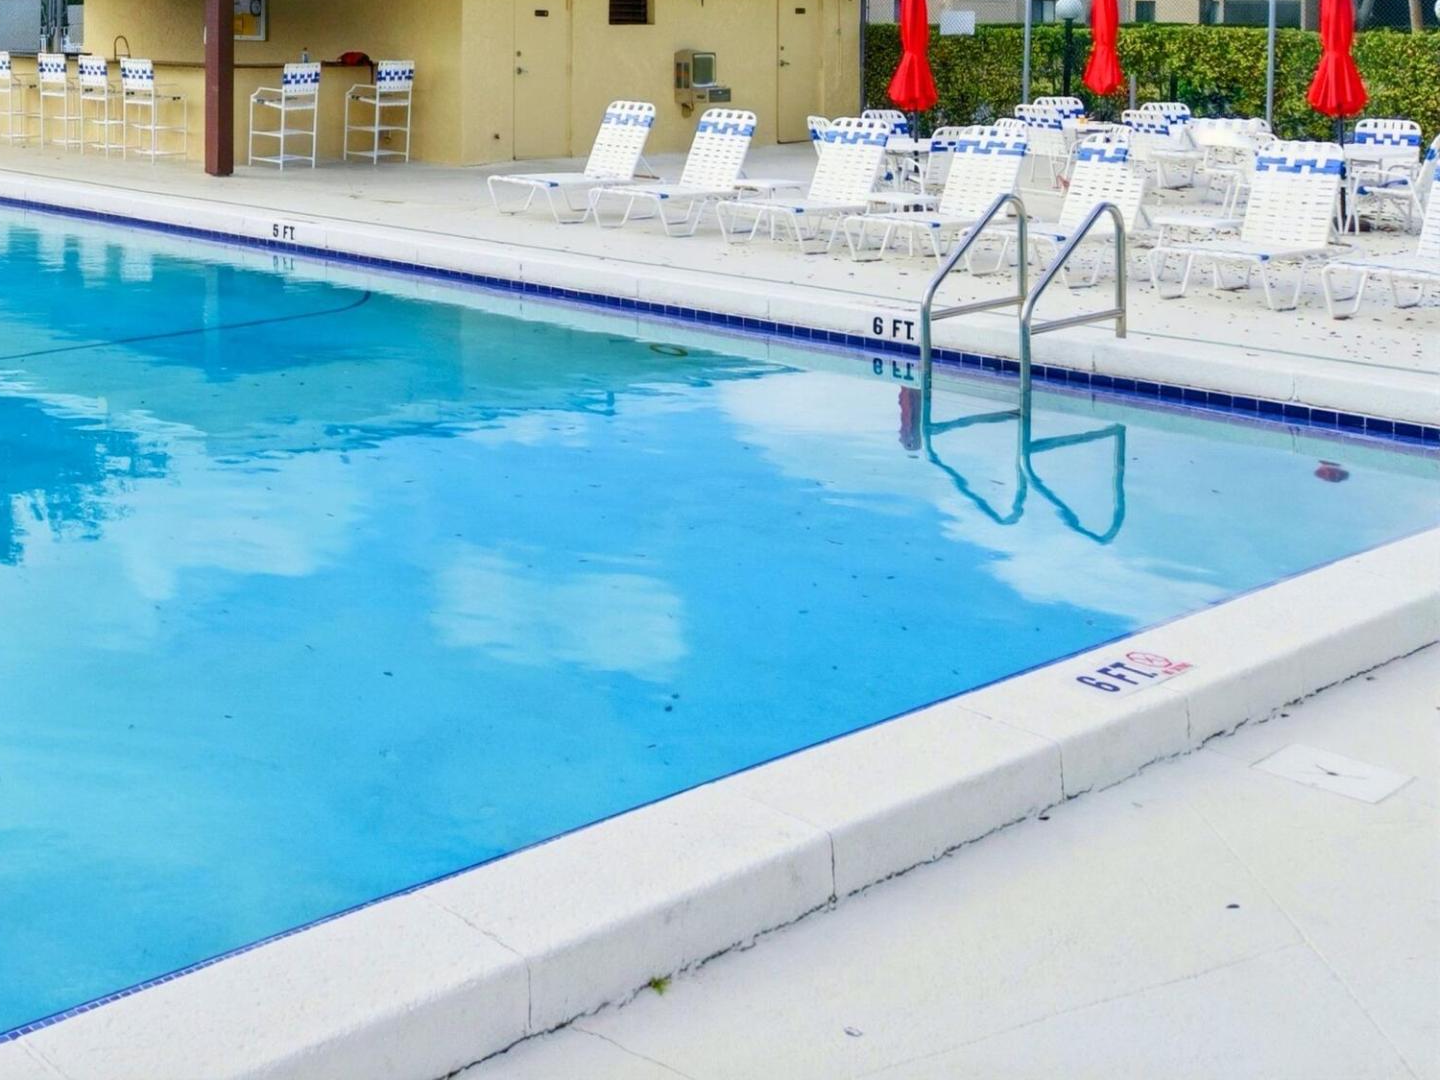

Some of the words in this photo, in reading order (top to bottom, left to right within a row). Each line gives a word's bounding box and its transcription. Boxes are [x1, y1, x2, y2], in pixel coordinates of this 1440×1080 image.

[273, 223, 279, 238] 5
[283, 225, 295, 240] FT
[873, 316, 884, 336] 6
[1076, 676, 1120, 692] 6
